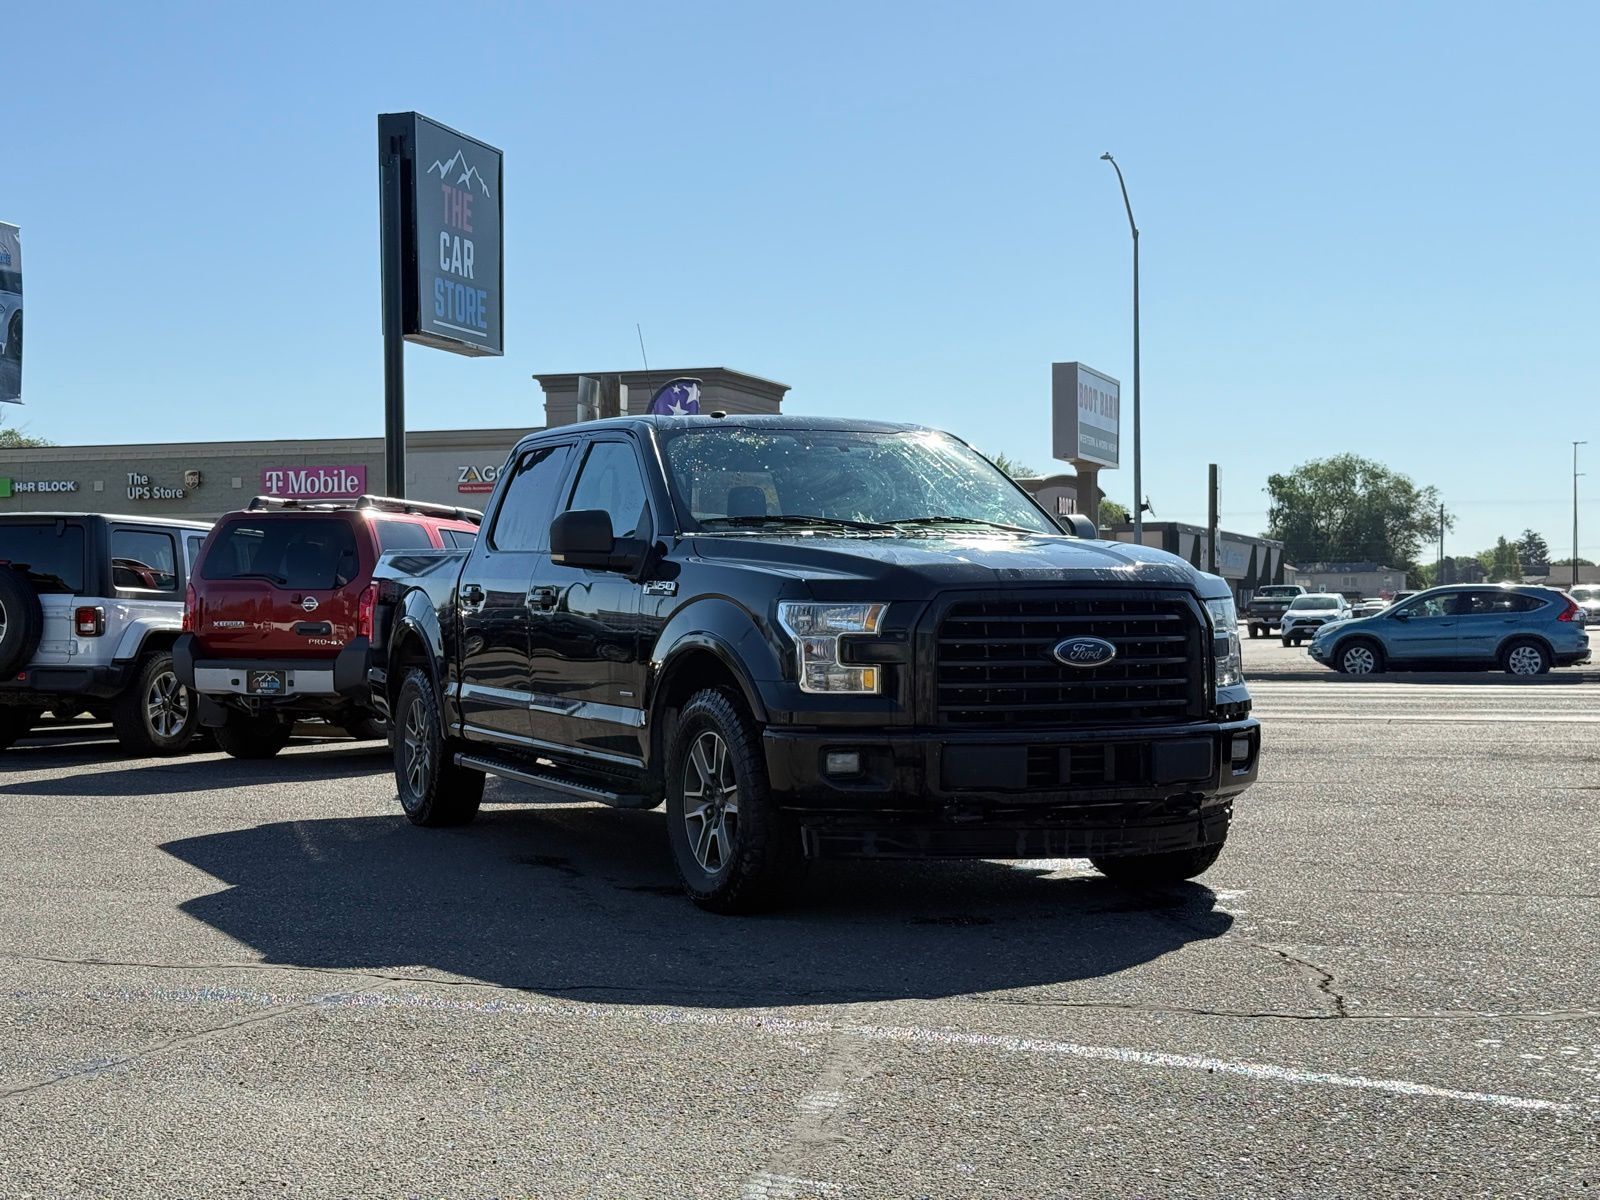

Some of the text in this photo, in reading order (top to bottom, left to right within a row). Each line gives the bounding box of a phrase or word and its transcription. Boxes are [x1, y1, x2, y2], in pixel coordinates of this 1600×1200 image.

[441, 184, 473, 233] THE
[439, 231, 474, 279] CAR
[434, 277, 487, 329] STORE
[1079, 382, 1098, 414] BOOT
[15, 481, 76, 492] H&R BLOCK
[127, 472, 149, 485] The
[287, 469, 359, 494] Mobile
[127, 486, 184, 499] UPS Store
[1070, 643, 1103, 660] Ford
